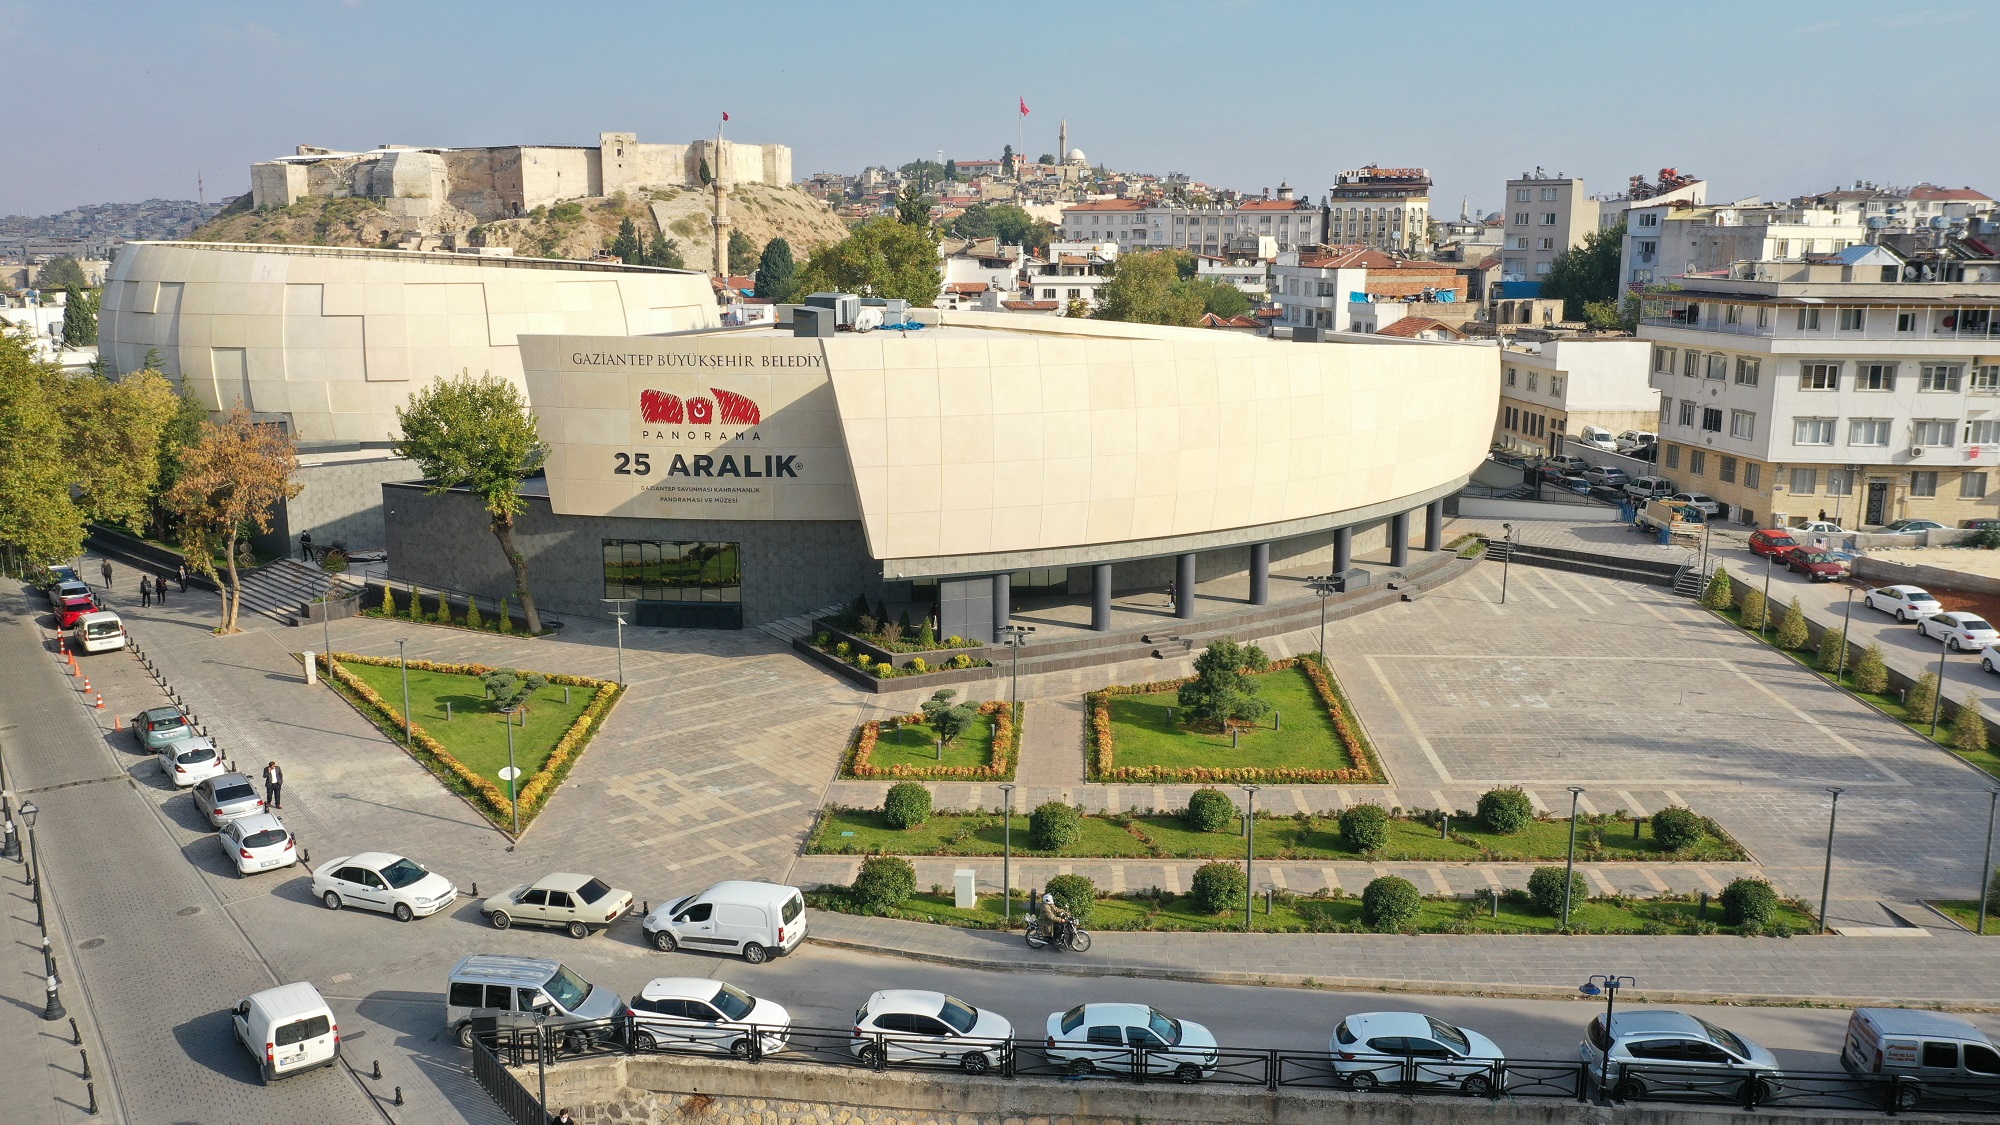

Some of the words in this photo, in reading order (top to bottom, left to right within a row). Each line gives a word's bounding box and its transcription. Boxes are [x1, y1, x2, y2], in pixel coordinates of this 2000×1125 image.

[1339, 169, 1370, 178] HOTEL
[1371, 168, 1422, 177] PRINCESS
[572, 351, 654, 366] GAZİANTEP
[658, 352, 756, 369] BÜYÜKŞEHİR
[642, 430, 761, 441] PANORAMA
[613, 452, 651, 476] 25
